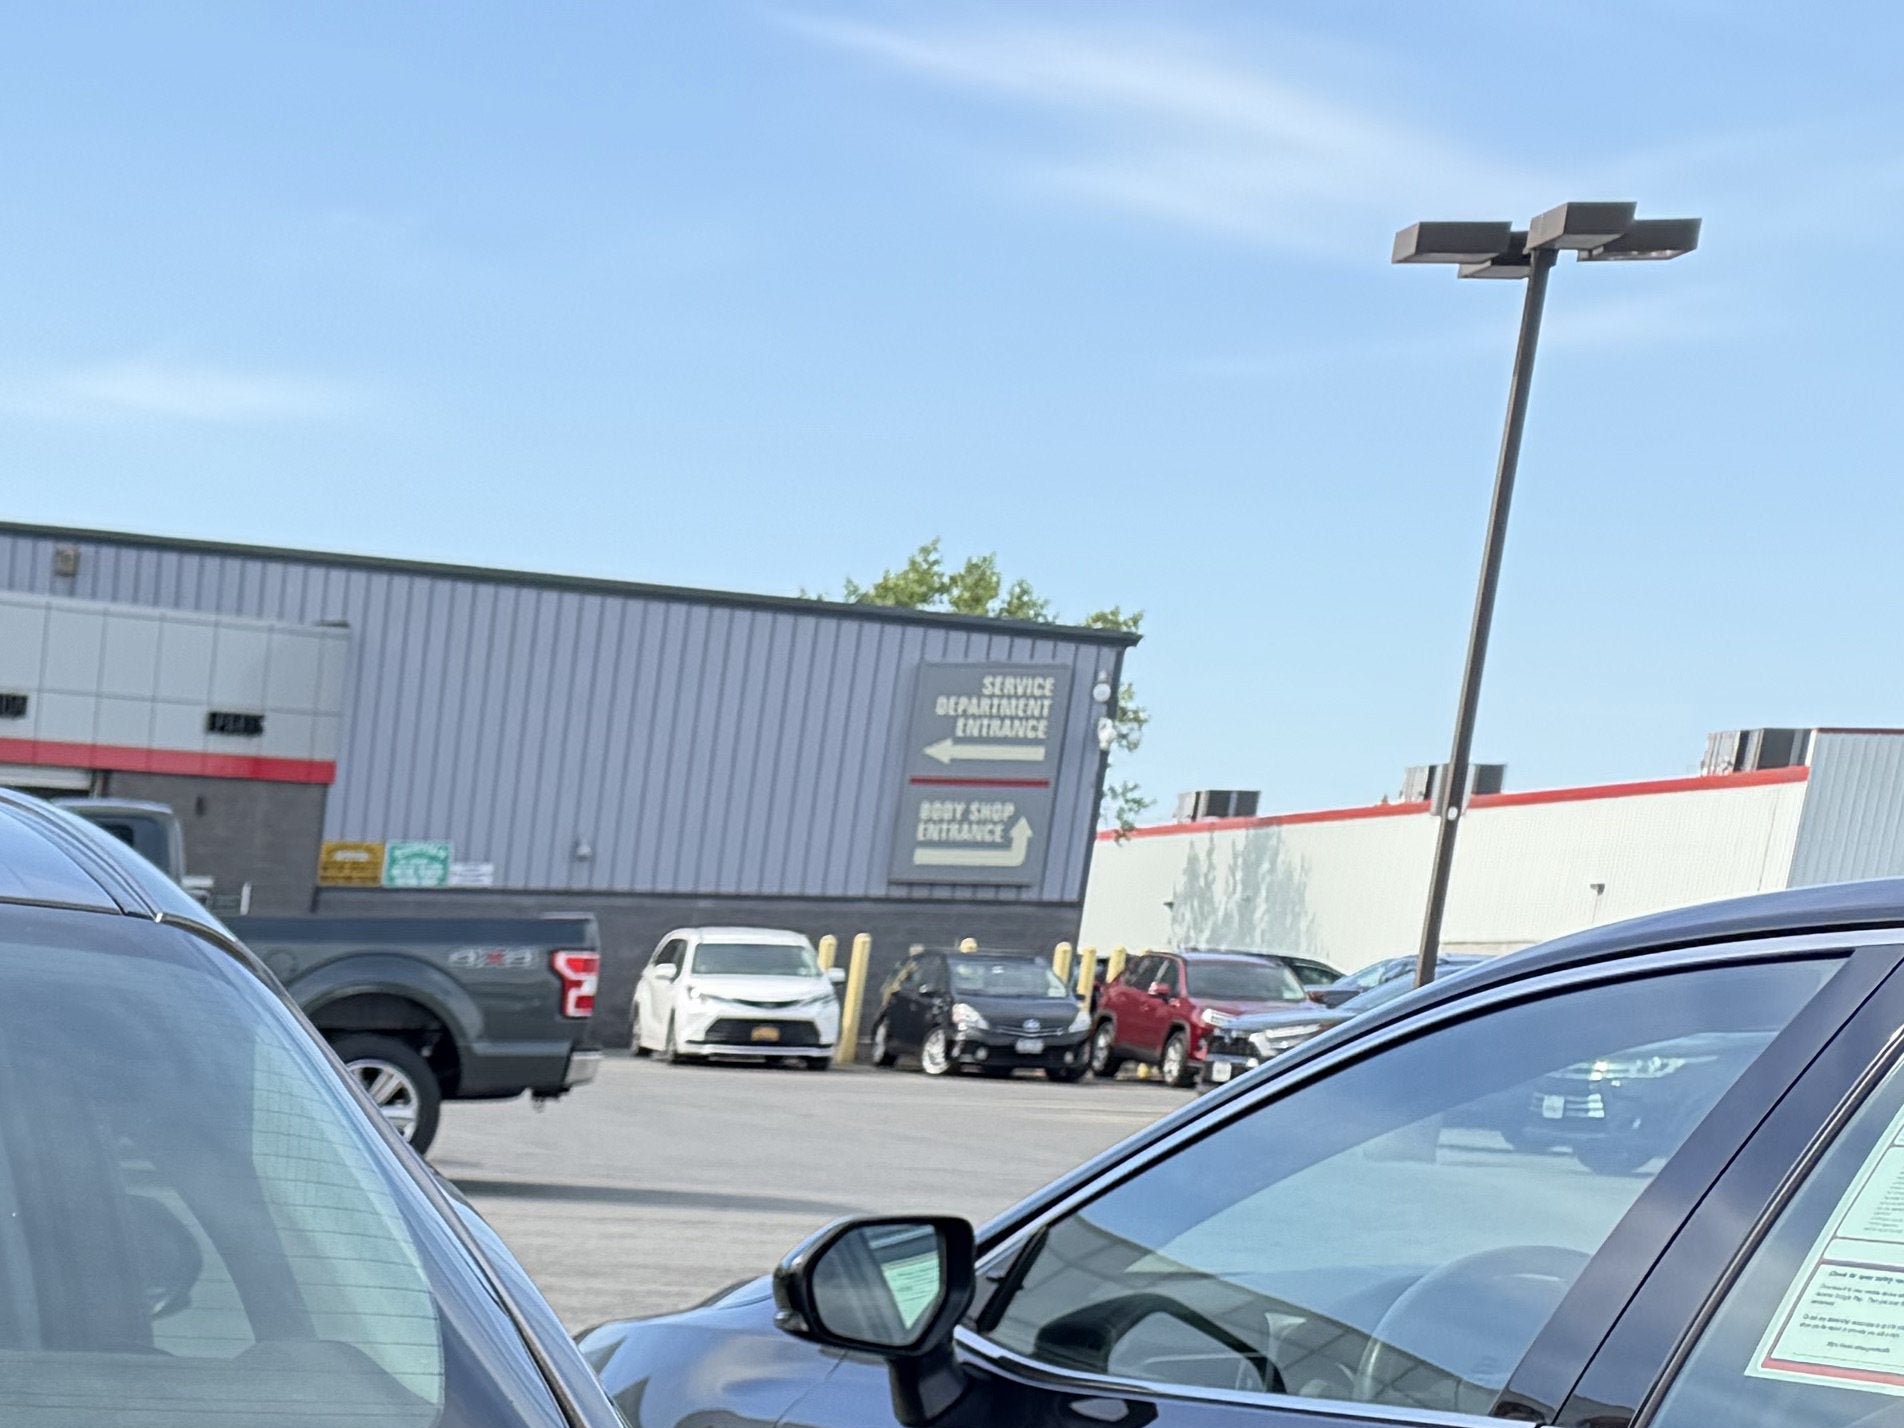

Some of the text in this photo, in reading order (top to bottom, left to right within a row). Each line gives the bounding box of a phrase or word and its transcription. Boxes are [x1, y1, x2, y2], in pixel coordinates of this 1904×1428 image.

[982, 675, 1055, 697] SERVICE
[935, 695, 1053, 718] DEPARTMENT
[956, 718, 1049, 739] ENTRANCE
[919, 800, 1015, 822] BODY SHOP
[917, 822, 1006, 843] ENTRANCE
